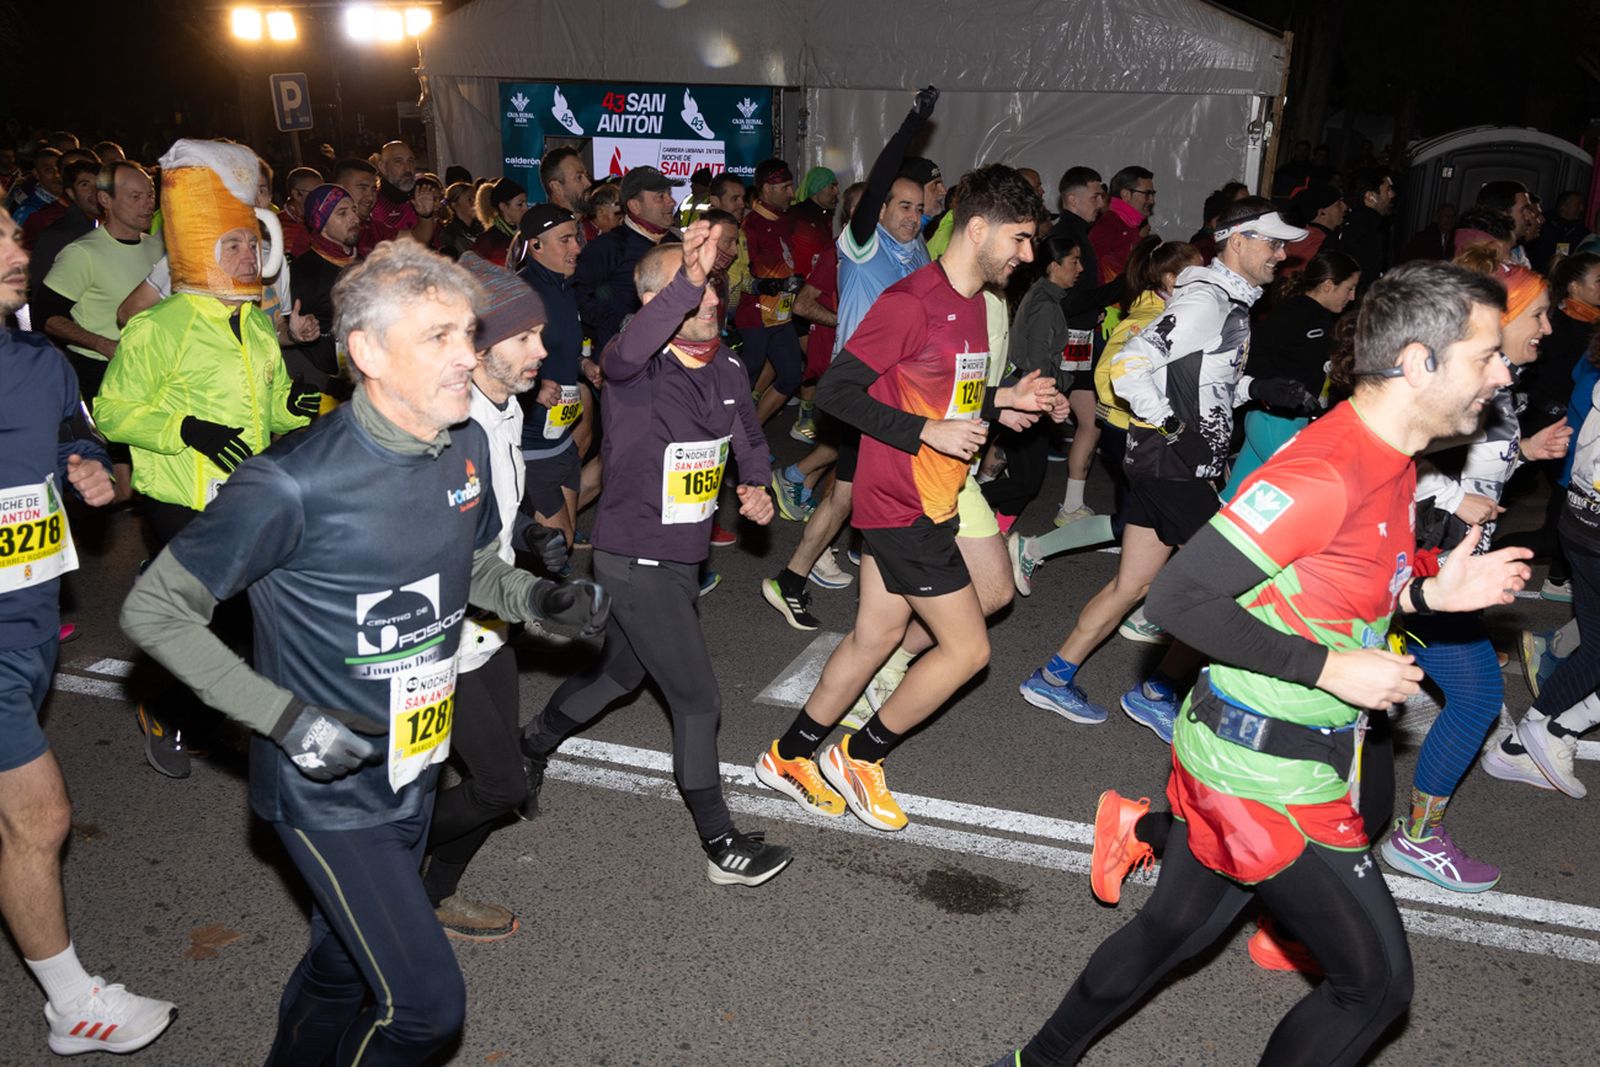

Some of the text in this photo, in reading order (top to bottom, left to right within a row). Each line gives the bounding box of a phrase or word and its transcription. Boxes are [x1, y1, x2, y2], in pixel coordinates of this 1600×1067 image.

[280, 80, 302, 124] P
[601, 92, 666, 112] 43 SAN
[561, 113, 574, 127] 43
[597, 110, 663, 134] ANTÓN
[691, 116, 704, 131] 43
[660, 161, 691, 176] SAN
[685, 450, 708, 460] NOCHE
[674, 461, 692, 471] SAN
[682, 467, 721, 496] 1653
[26, 496, 40, 507] DE
[0, 514, 60, 557] 3278
[366, 606, 429, 627] CENTRO DE
[405, 694, 426, 710] SAN
